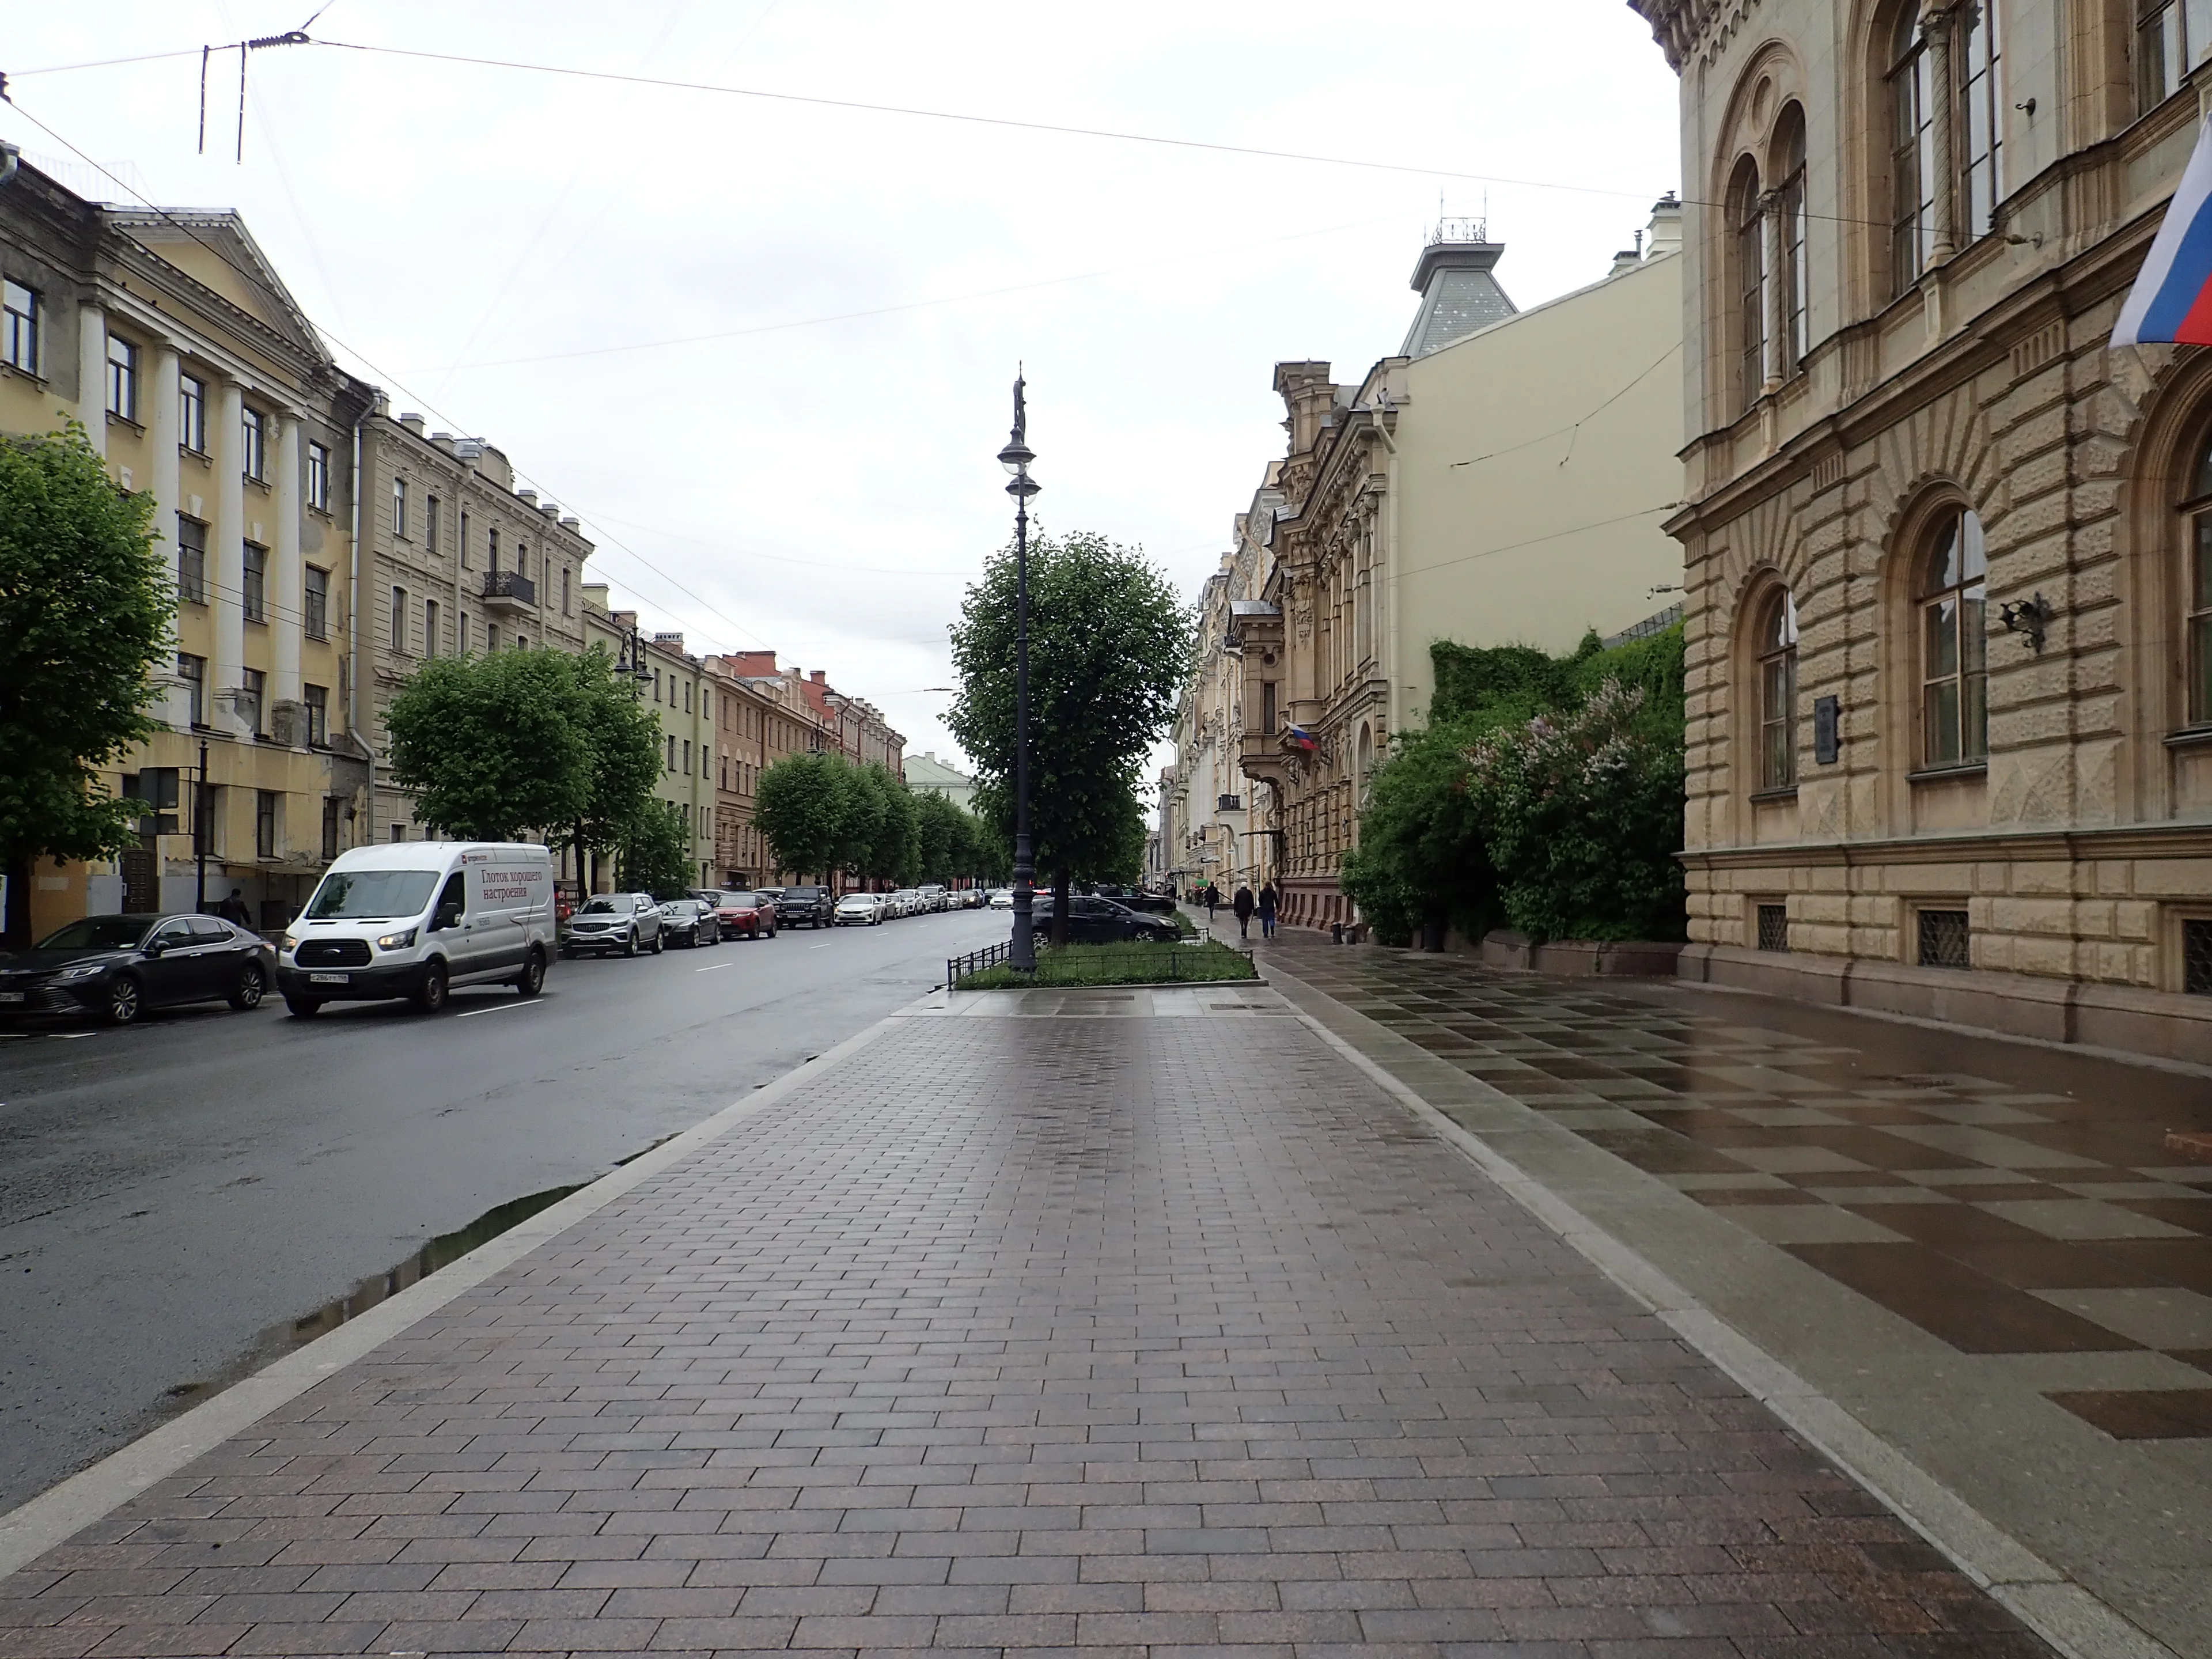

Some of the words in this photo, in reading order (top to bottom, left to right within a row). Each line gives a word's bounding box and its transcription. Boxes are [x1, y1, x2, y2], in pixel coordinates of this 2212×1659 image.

[482, 869, 509, 883] Глоток
[510, 872, 542, 885] хорошего
[483, 888, 527, 903] настроения
